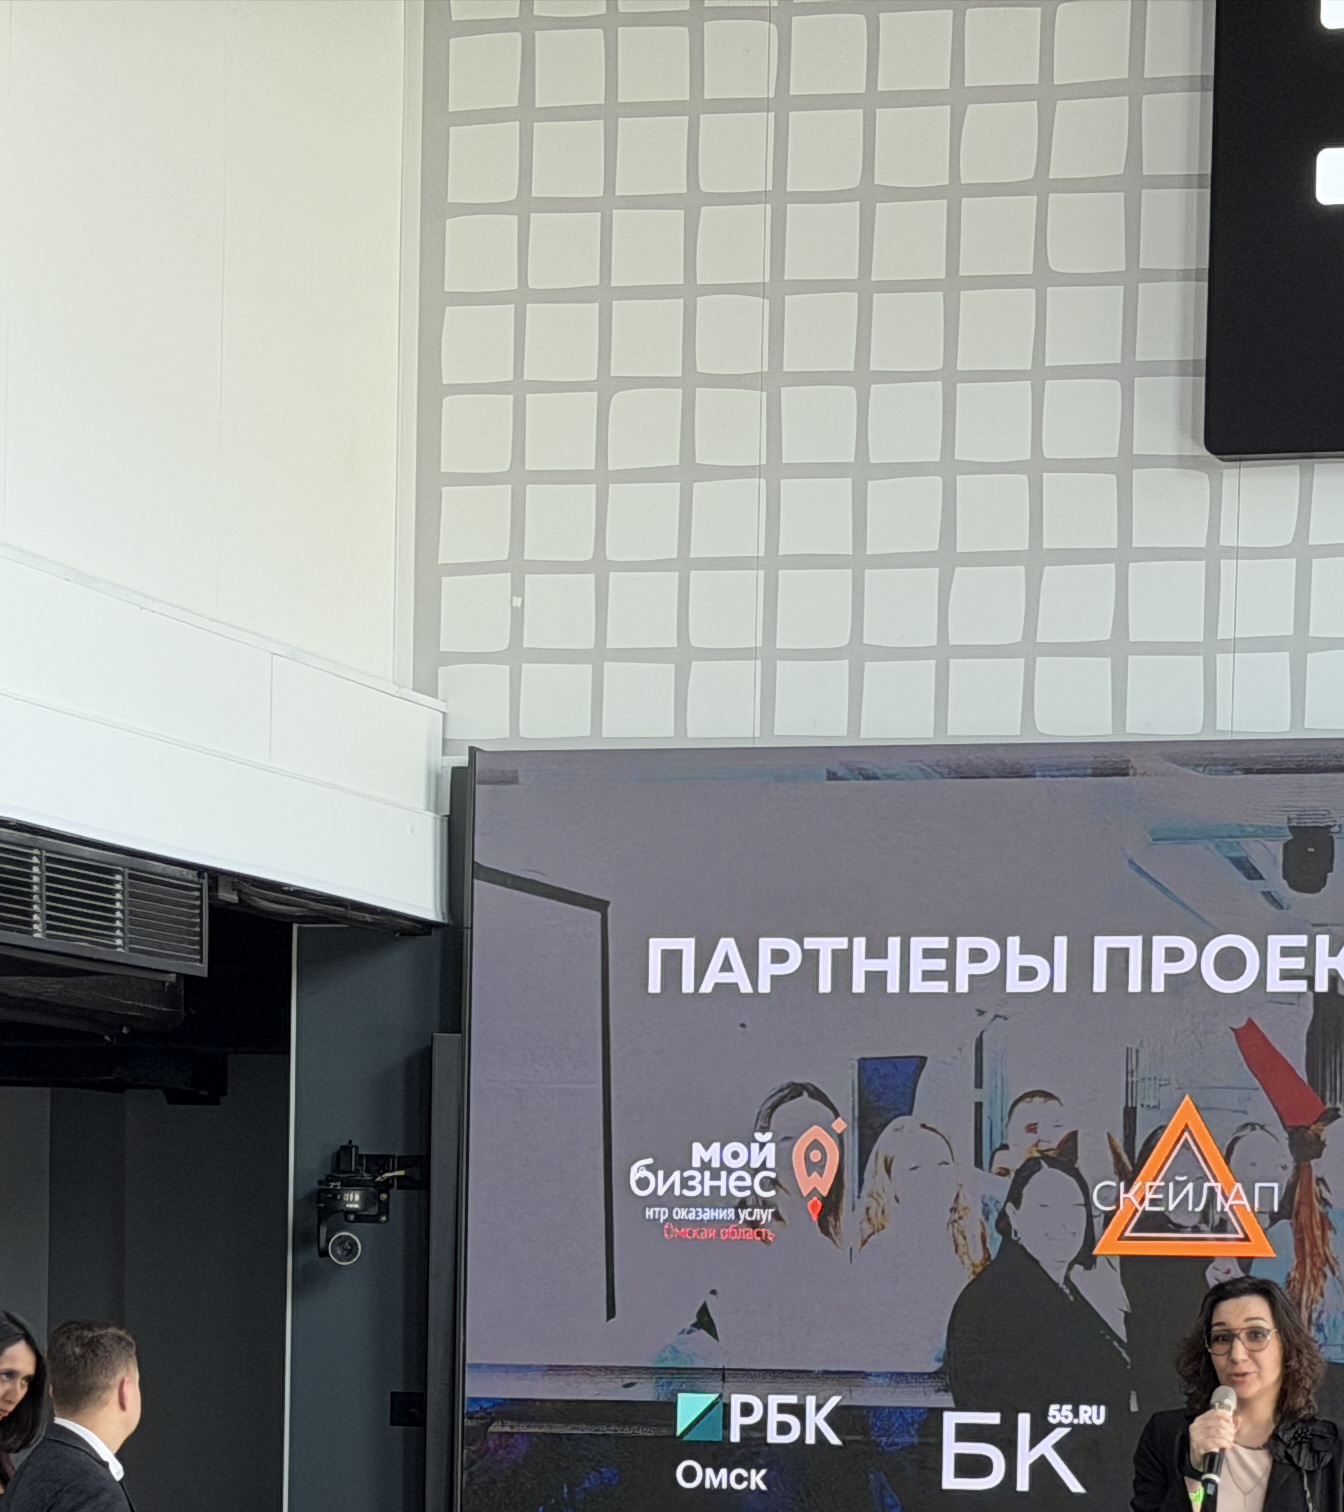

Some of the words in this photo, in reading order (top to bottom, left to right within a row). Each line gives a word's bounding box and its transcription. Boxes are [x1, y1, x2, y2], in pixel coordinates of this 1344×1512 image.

[647, 935, 1067, 994] ПАРТНЕРЫ
[691, 1132, 776, 1169] мой
[629, 1157, 777, 1198] бизнес
[1092, 1175, 1279, 1213] СКЕЙЛАП
[663, 1222, 716, 1240] Омская
[720, 1224, 776, 1242] область
[672, 1206, 736, 1221] оказания
[737, 1207, 775, 1225] услуг
[728, 1393, 844, 1446] РБК
[1047, 1404, 1106, 1426] 55.RU
[941, 1410, 1087, 1494] БК
